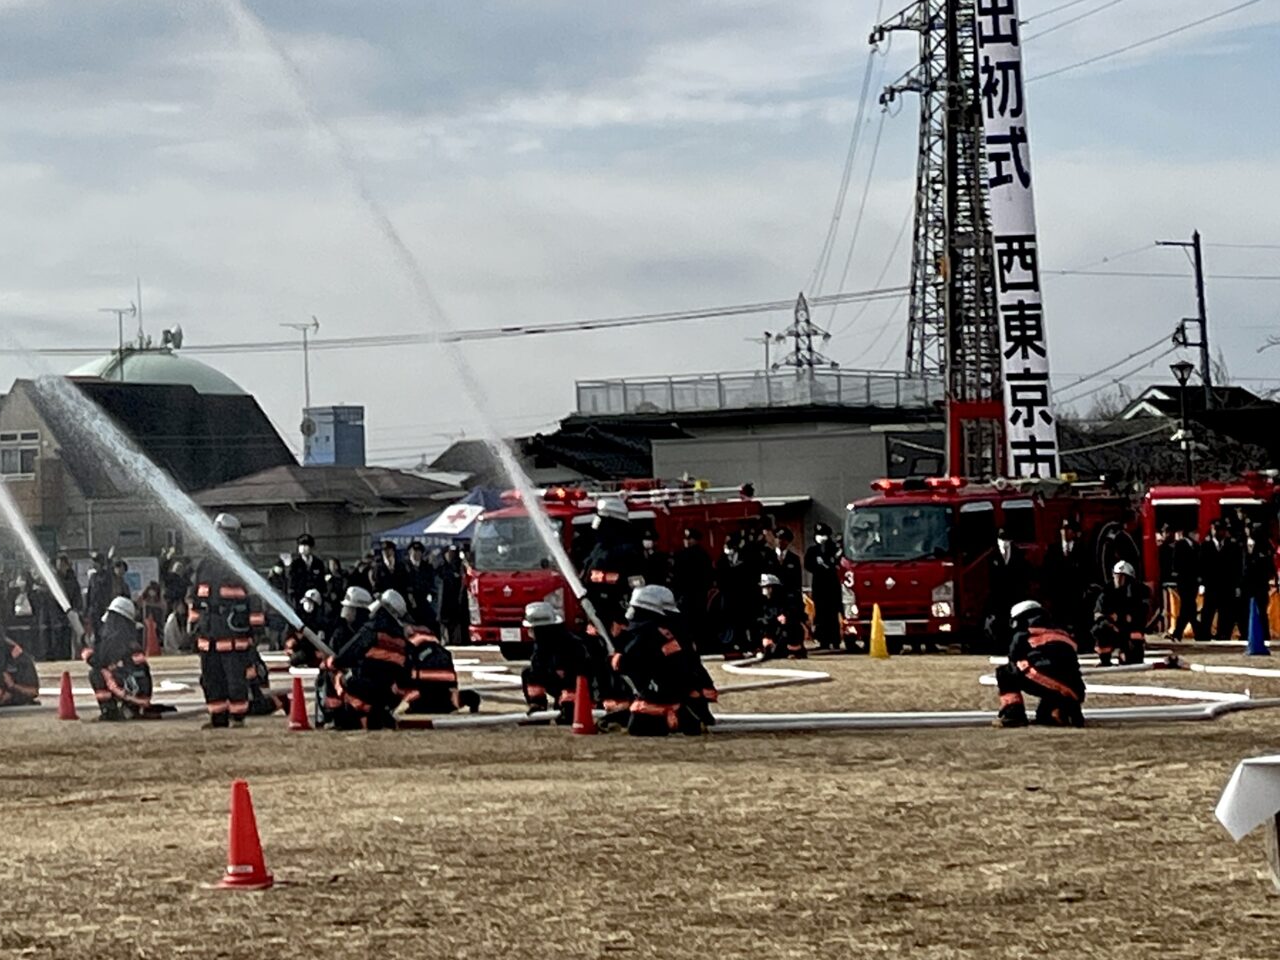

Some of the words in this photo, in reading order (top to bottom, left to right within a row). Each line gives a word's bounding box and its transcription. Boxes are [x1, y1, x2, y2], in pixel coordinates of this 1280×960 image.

[994, 233, 1057, 478] 西東京市
[843, 571, 854, 587] 3
